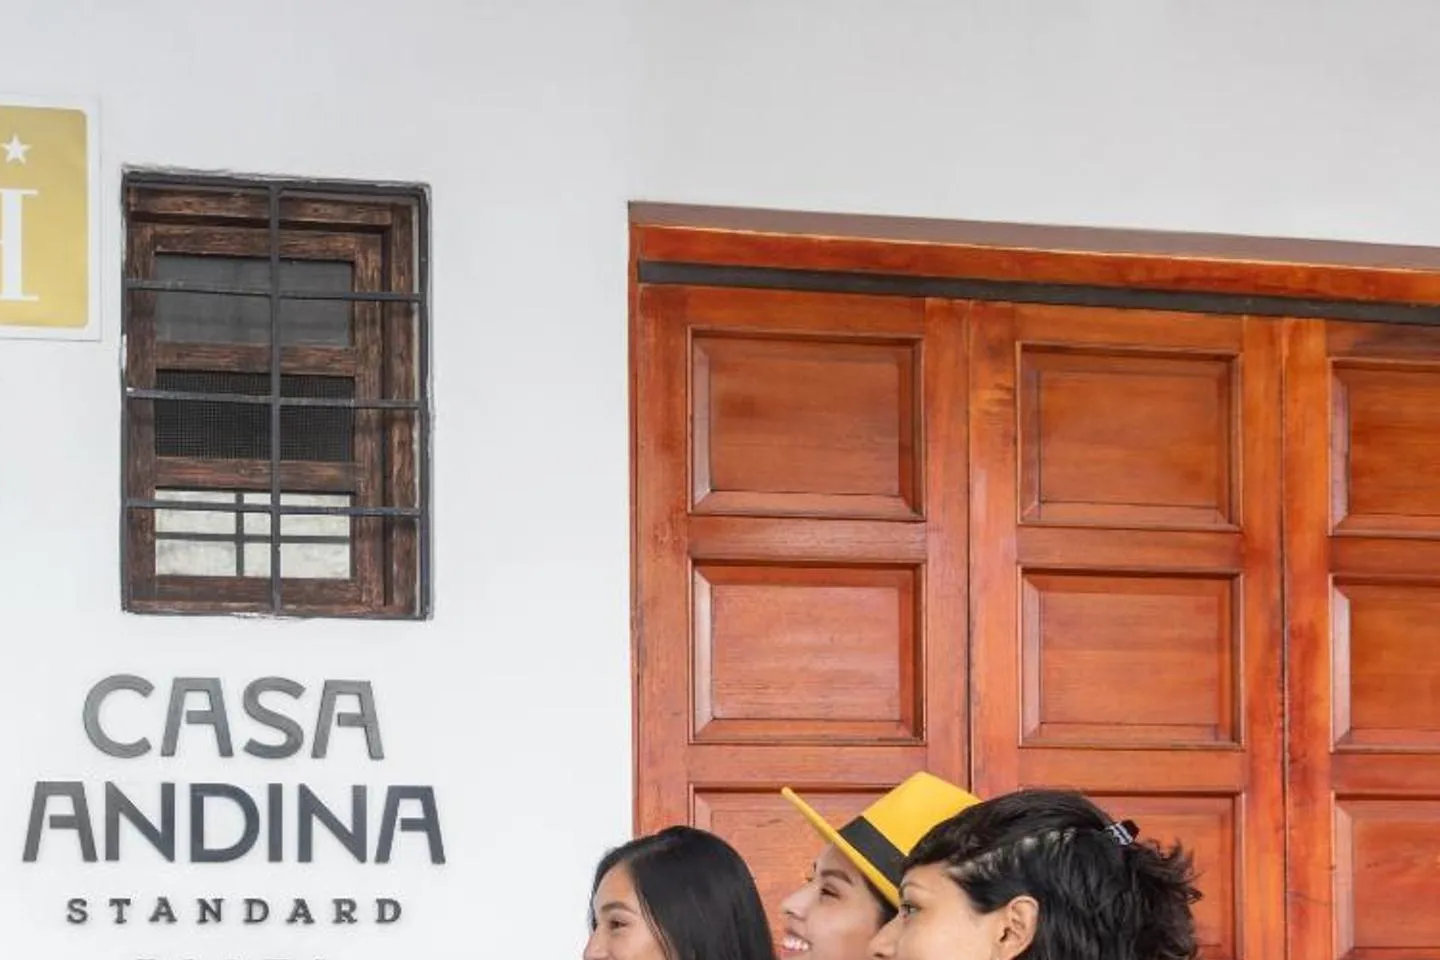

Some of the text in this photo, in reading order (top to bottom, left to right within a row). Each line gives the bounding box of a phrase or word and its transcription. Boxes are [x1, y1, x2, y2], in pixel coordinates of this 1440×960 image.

[83, 674, 385, 760] CASA
[22, 780, 447, 865] ANDINA
[65, 896, 404, 926] STANDARD
